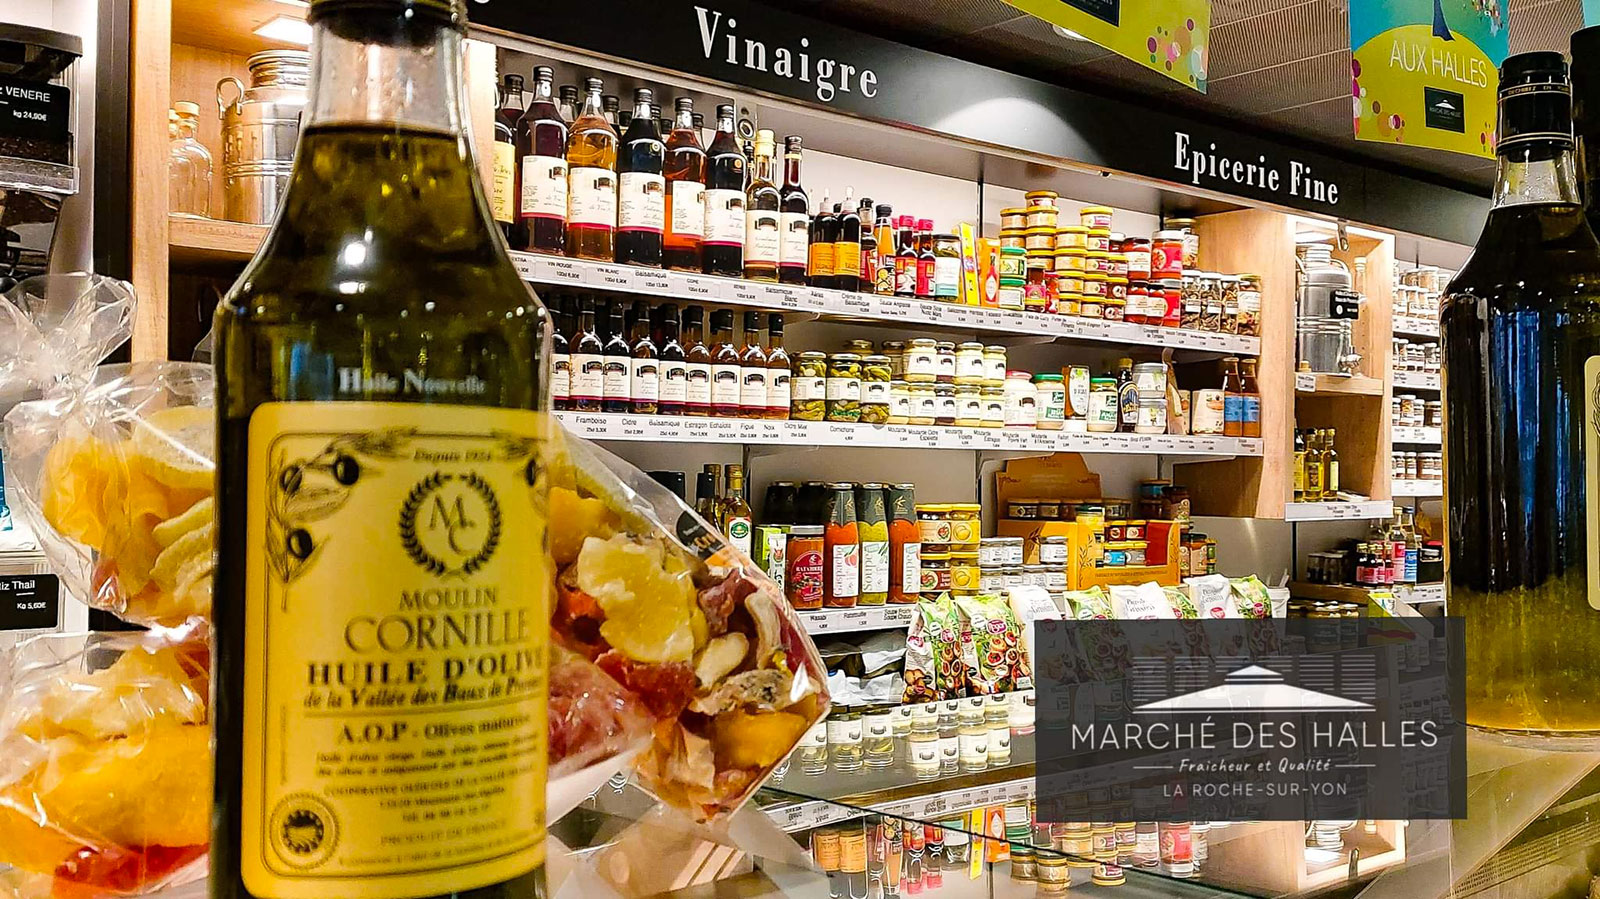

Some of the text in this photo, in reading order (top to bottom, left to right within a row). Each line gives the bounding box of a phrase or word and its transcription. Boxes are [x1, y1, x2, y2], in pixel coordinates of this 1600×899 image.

[694, 5, 879, 102] Vinaigre
[1389, 40, 1487, 89] AUX HALLES
[5, 86, 51, 103] VENERE
[1174, 132, 1340, 205] Epicerie Fine
[575, 415, 607, 425] Framboise
[621, 418, 637, 426] Cidre
[834, 546, 845, 596] Gaspacho
[863, 554, 876, 591] Soupe
[904, 555, 914, 591] Soupe
[400, 588, 496, 612] MOULIN
[344, 609, 528, 653] CORNILLE
[308, 657, 427, 686] HUILE
[424, 724, 475, 740] Olives
